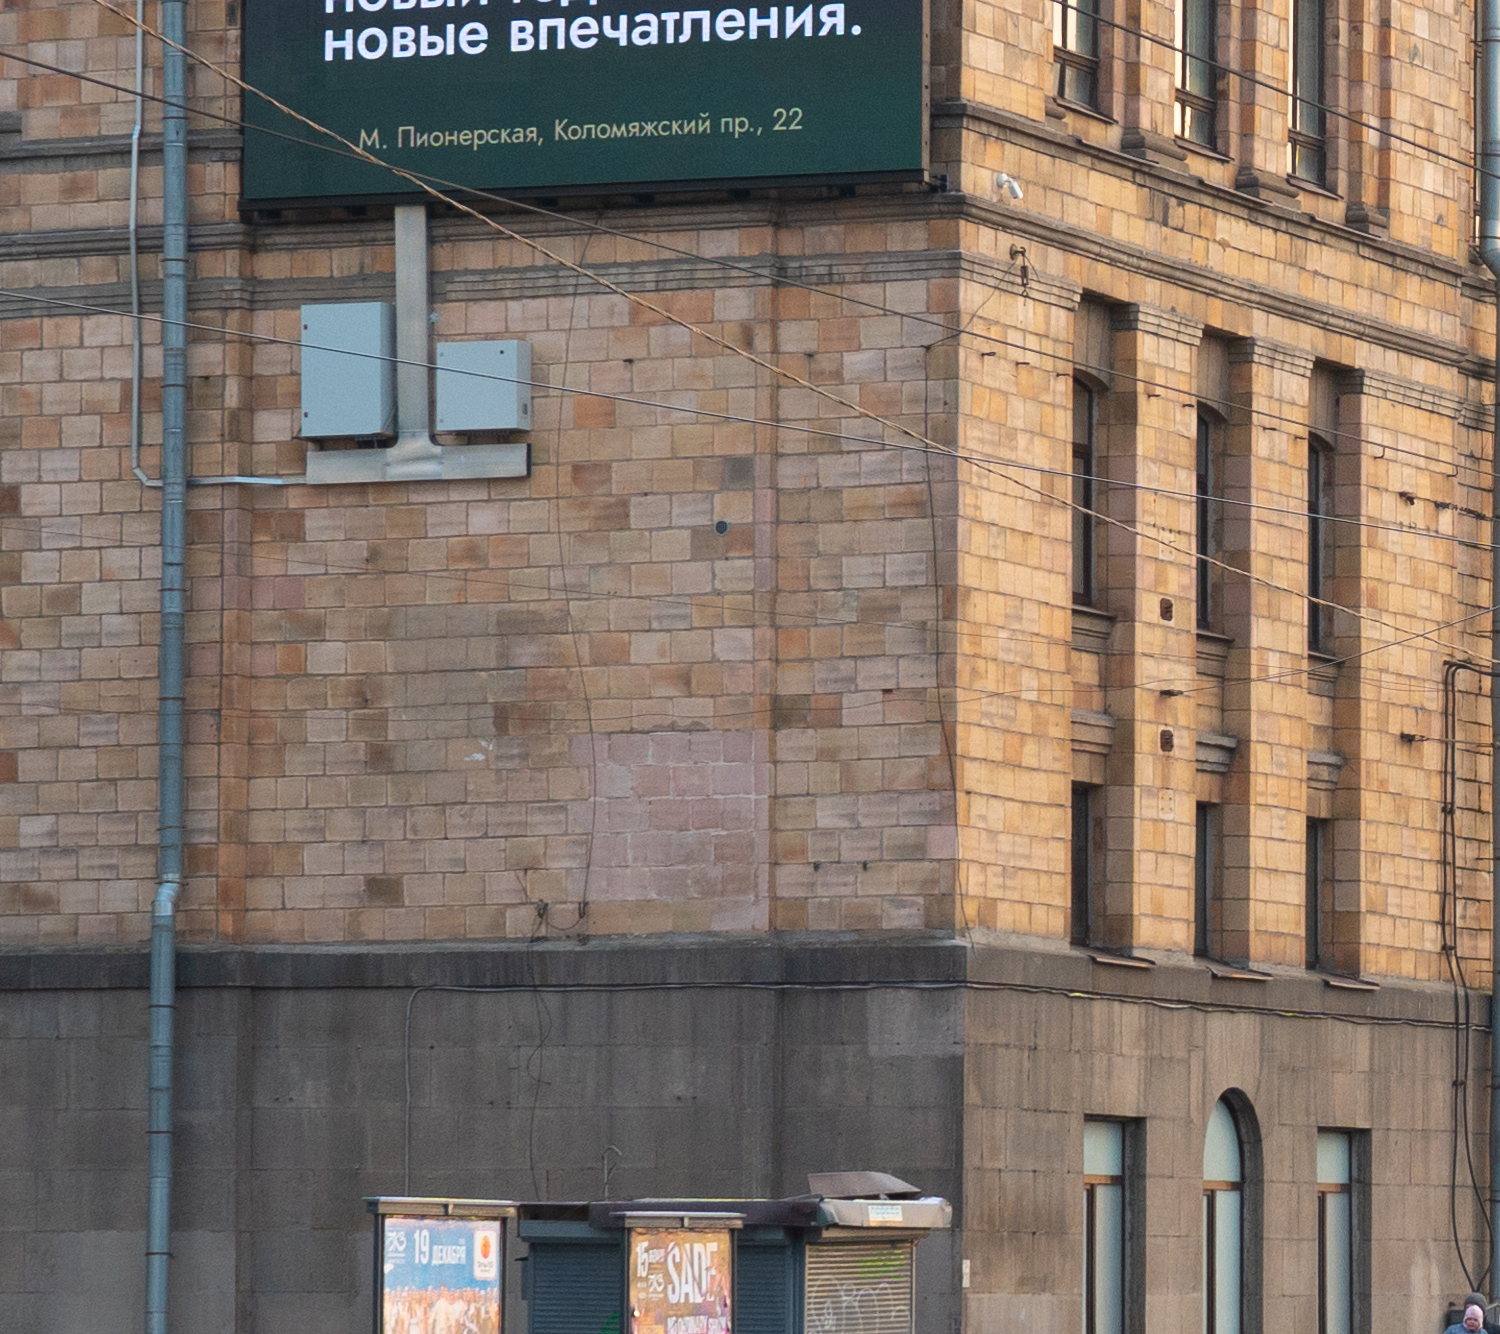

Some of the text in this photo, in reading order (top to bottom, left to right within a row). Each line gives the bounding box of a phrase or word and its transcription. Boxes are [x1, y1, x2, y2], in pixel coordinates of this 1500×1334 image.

[325, 3, 862, 61] новые впечатления.
[359, 108, 803, 150] М. Пионерская, Коломяжский пр., 22
[414, 1229, 430, 1264] 19
[432, 1245, 467, 1266] ДЕКАБРЯ
[636, 1241, 649, 1278] 15
[667, 1241, 718, 1304] SADE
